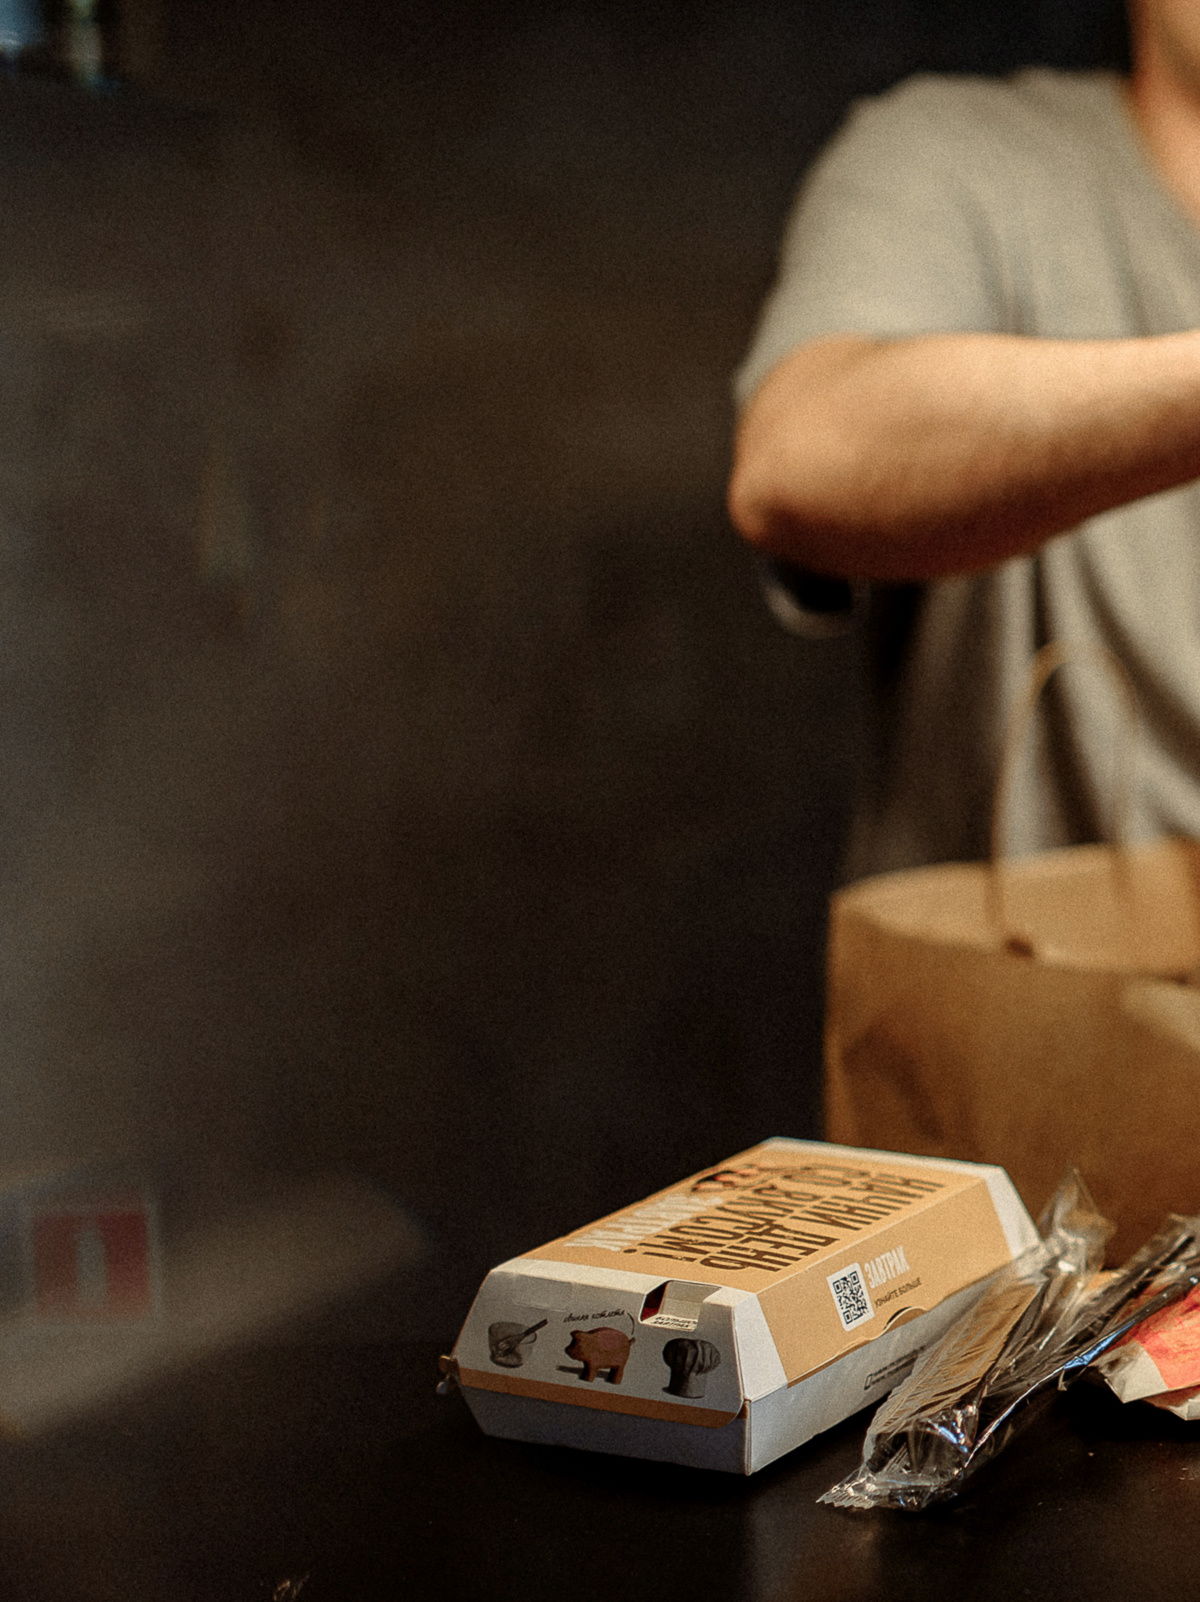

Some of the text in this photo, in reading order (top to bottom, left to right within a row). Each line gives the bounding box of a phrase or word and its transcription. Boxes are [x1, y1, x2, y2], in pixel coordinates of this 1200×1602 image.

[563, 1193, 723, 1252] ЗАВТРАК
[624, 1184, 823, 1262] ВКУСОМ!
[699, 1173, 944, 1272] НАЧНИ ДЕНЬ
[864, 1245, 910, 1289] ЗАВТРАК
[874, 1289, 899, 1308] УЗНАЙТЕ
